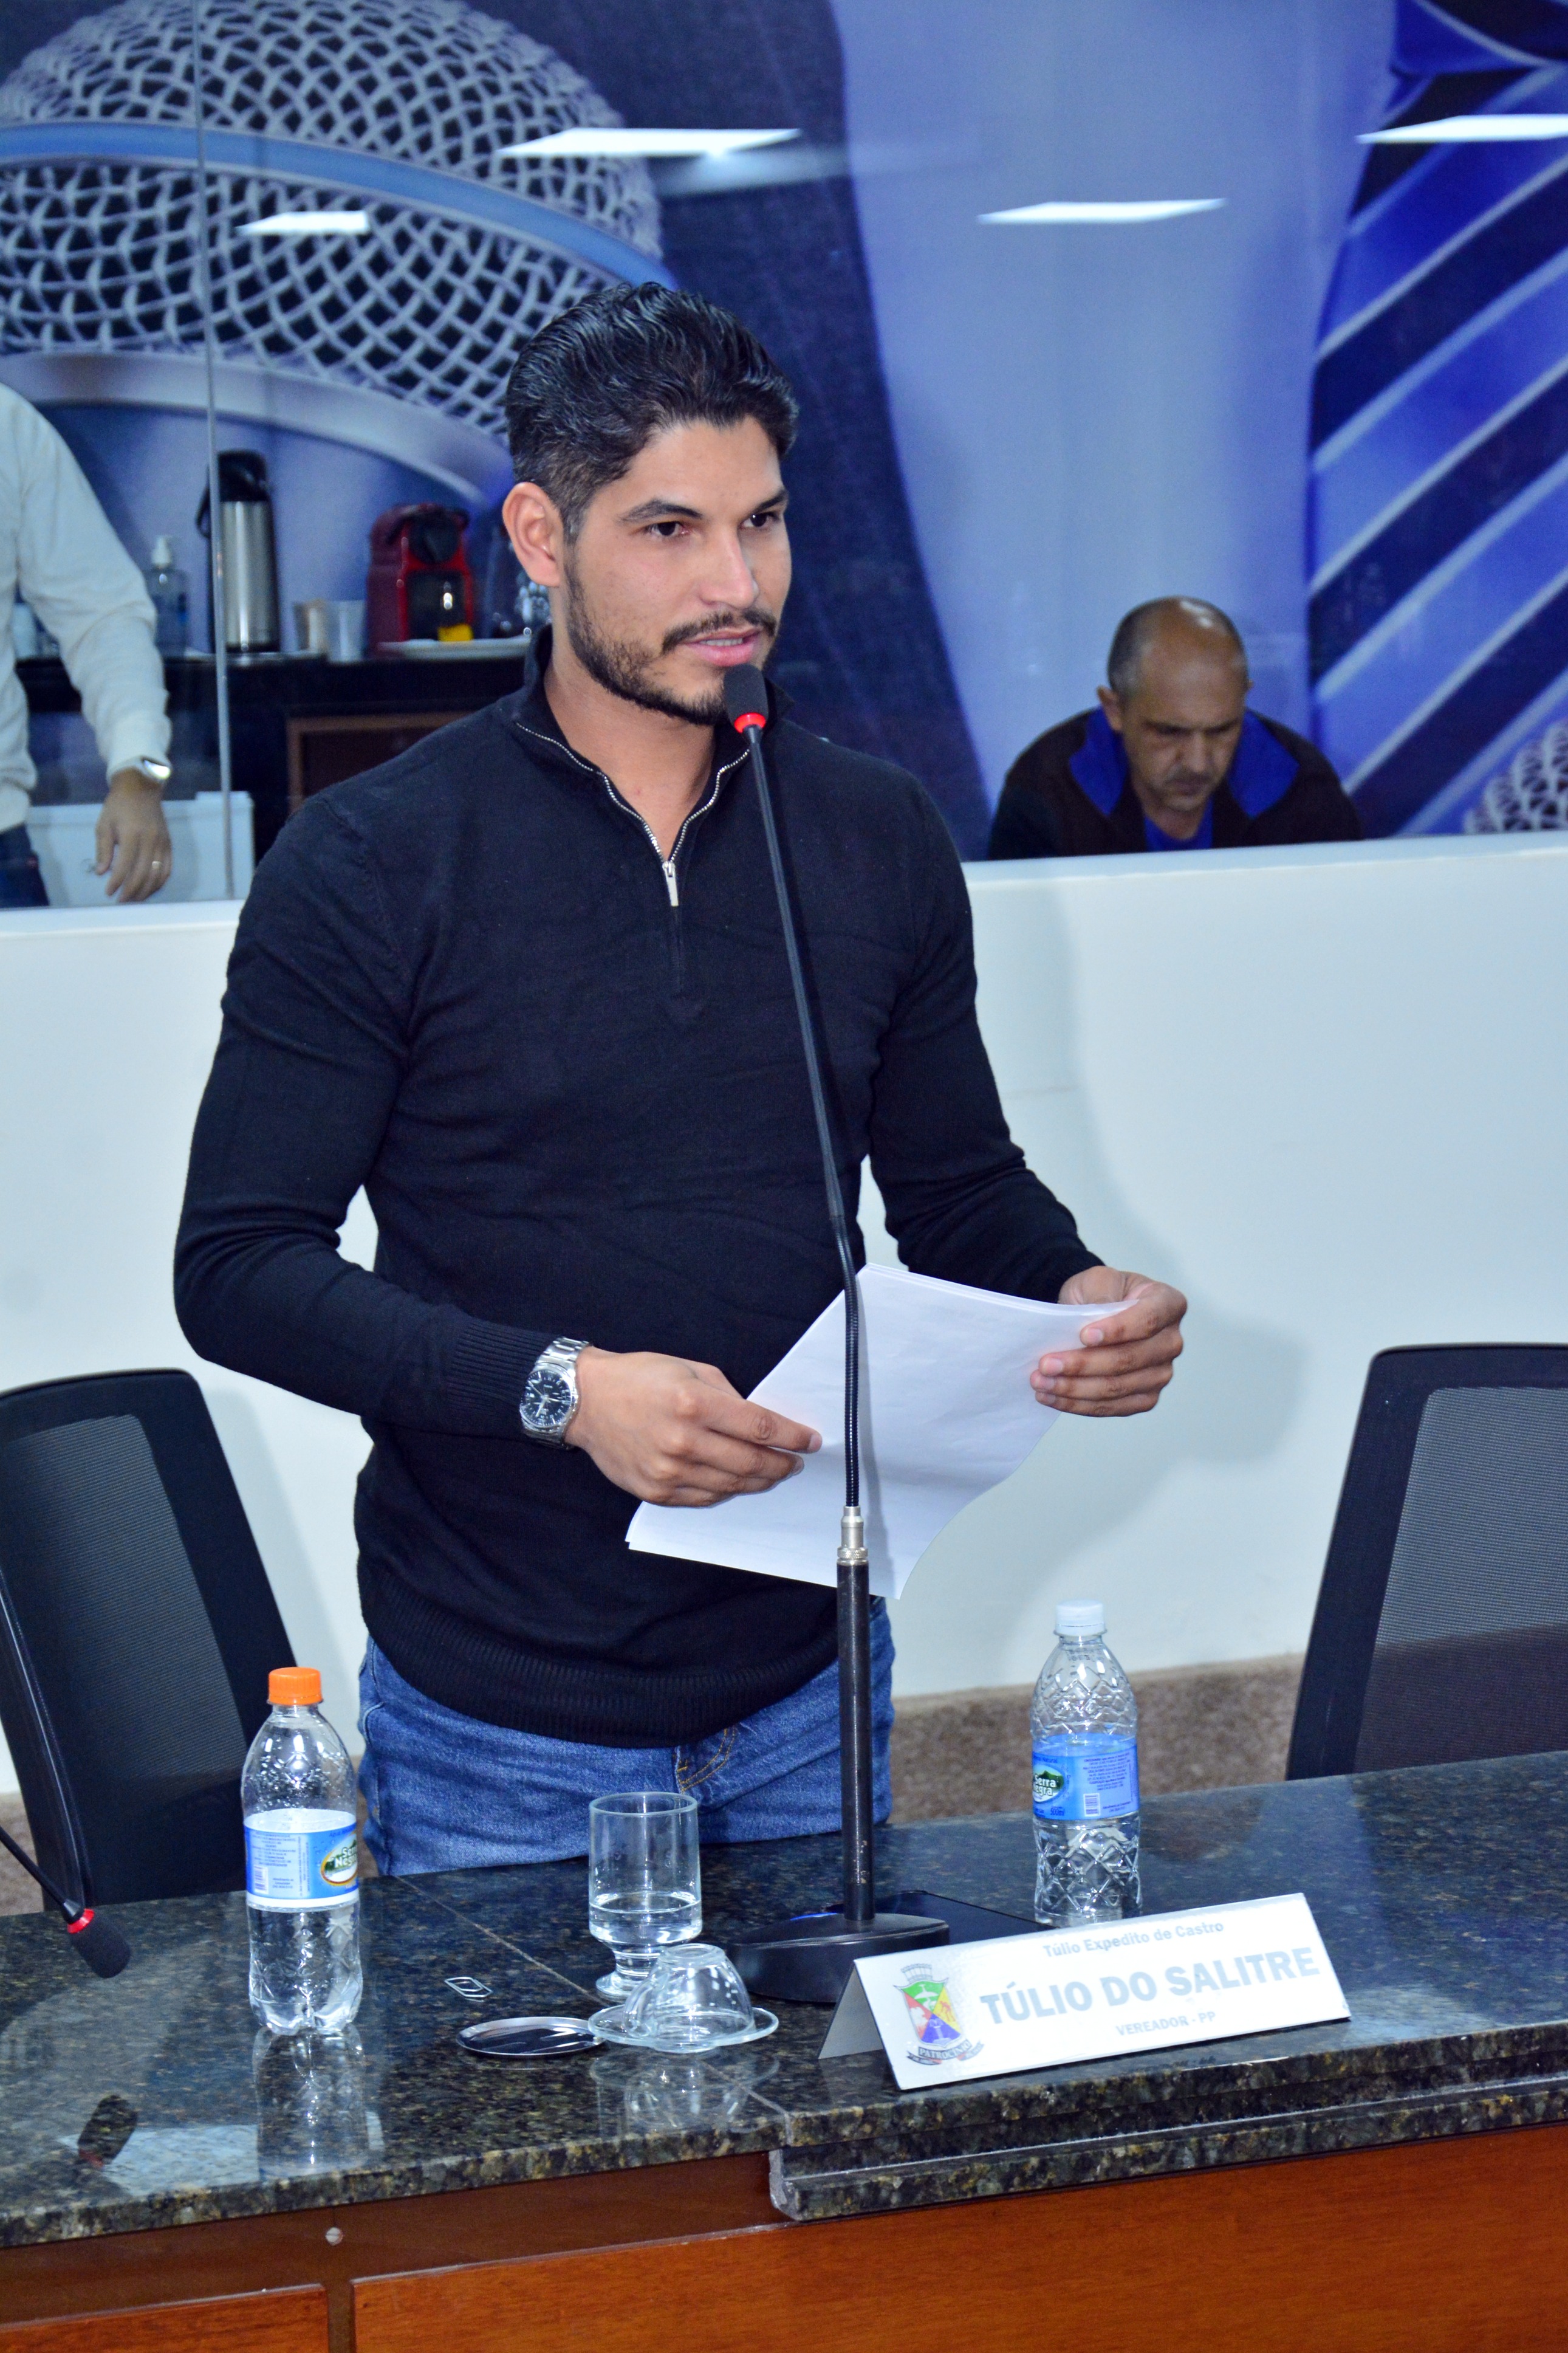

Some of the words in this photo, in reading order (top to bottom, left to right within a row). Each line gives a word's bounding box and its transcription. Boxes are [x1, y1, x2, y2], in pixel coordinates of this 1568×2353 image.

[1035, 1774, 1056, 1788] Serra
[1042, 1942, 1081, 1957] Túlio
[1083, 1932, 1150, 1952] Expedito
[1153, 1928, 1173, 1942] de
[1175, 1922, 1224, 1938] Castro
[979, 1980, 1093, 2025] TÚLIO
[1099, 1971, 1158, 2007] DO
[1165, 1946, 1321, 1997] SALITRE
[1115, 2015, 1190, 2036] VEREADOR
[1198, 2010, 1216, 2023] PP
